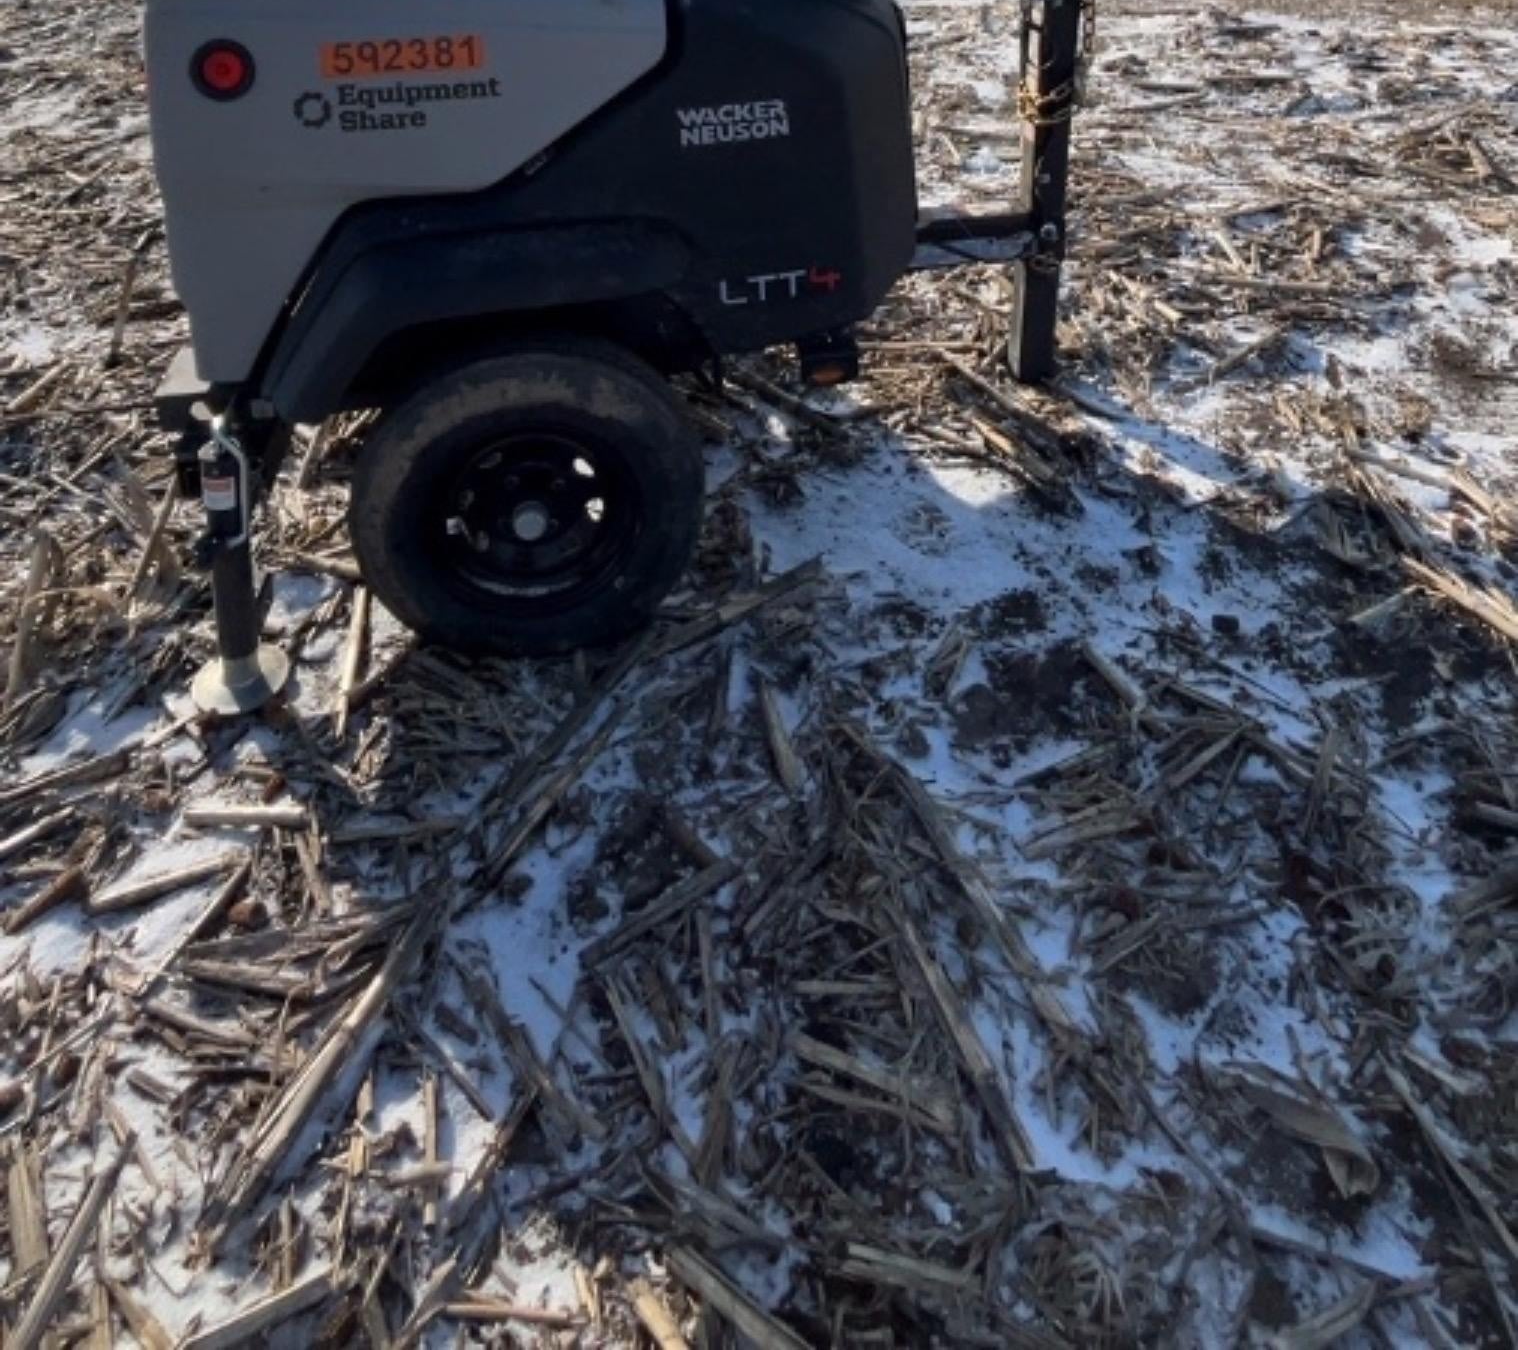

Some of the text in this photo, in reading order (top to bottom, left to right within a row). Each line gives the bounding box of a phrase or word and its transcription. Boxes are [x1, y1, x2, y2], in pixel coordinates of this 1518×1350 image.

[332, 35, 477, 75] 592381
[336, 77, 501, 107] Equipment
[338, 110, 427, 131] Share
[677, 99, 786, 127] WACKER
[680, 119, 790, 146] NEUSON
[719, 265, 841, 304] LTT4
